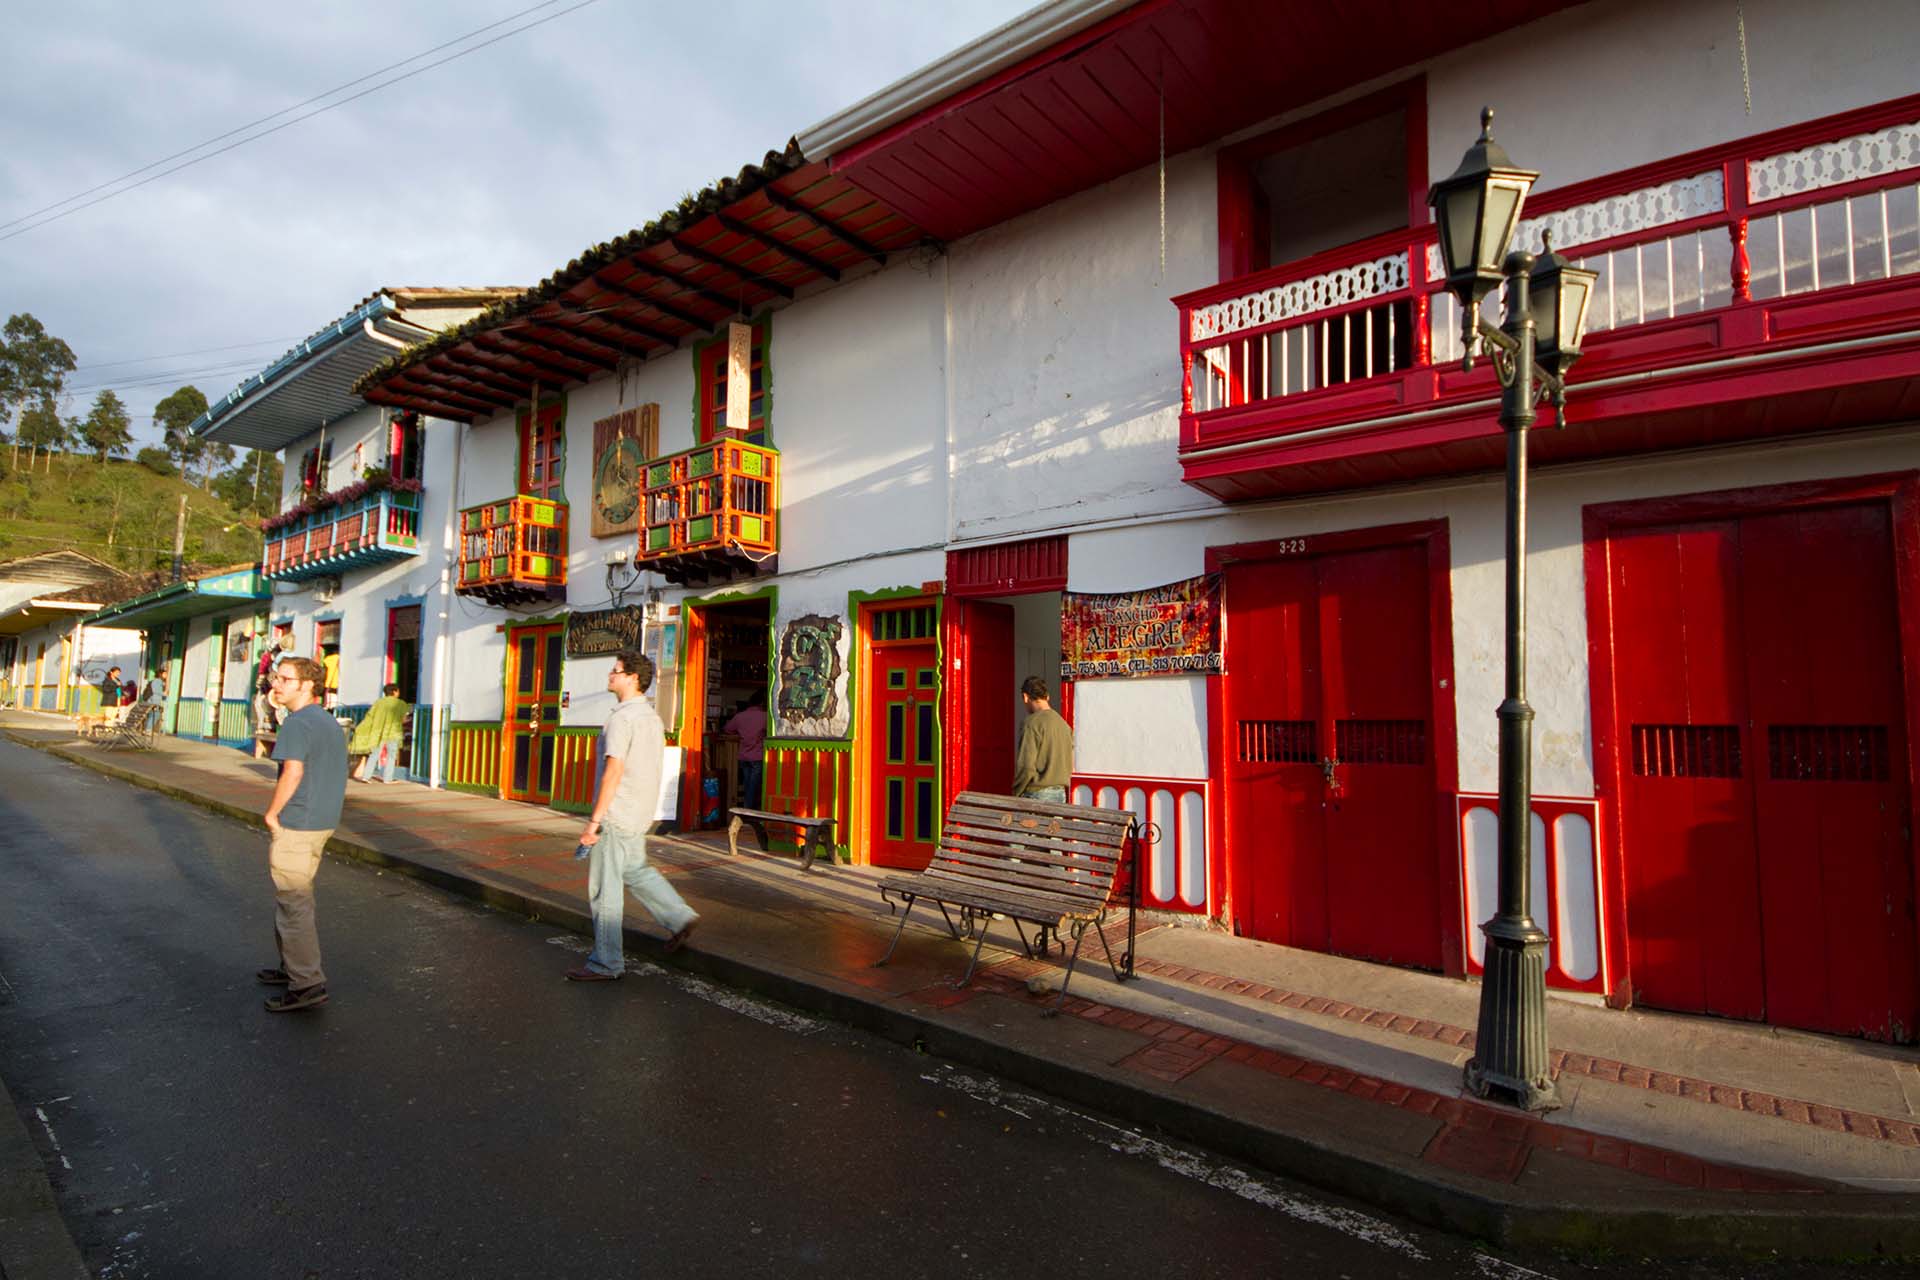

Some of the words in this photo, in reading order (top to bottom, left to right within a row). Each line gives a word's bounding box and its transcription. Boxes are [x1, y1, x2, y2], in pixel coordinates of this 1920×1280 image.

[1280, 540, 1305, 554] 3-23
[1091, 585, 1183, 611] HOSTAL
[1105, 608, 1159, 625] RANCHO
[1085, 619, 1184, 651] ALEGRE
[1061, 662, 1077, 674] EL.
[1078, 661, 1096, 674] 759
[1128, 659, 1150, 672] CEL.
[1170, 655, 1192, 669] 707
[1193, 654, 1205, 668] 71
[1206, 651, 1221, 668] 87
